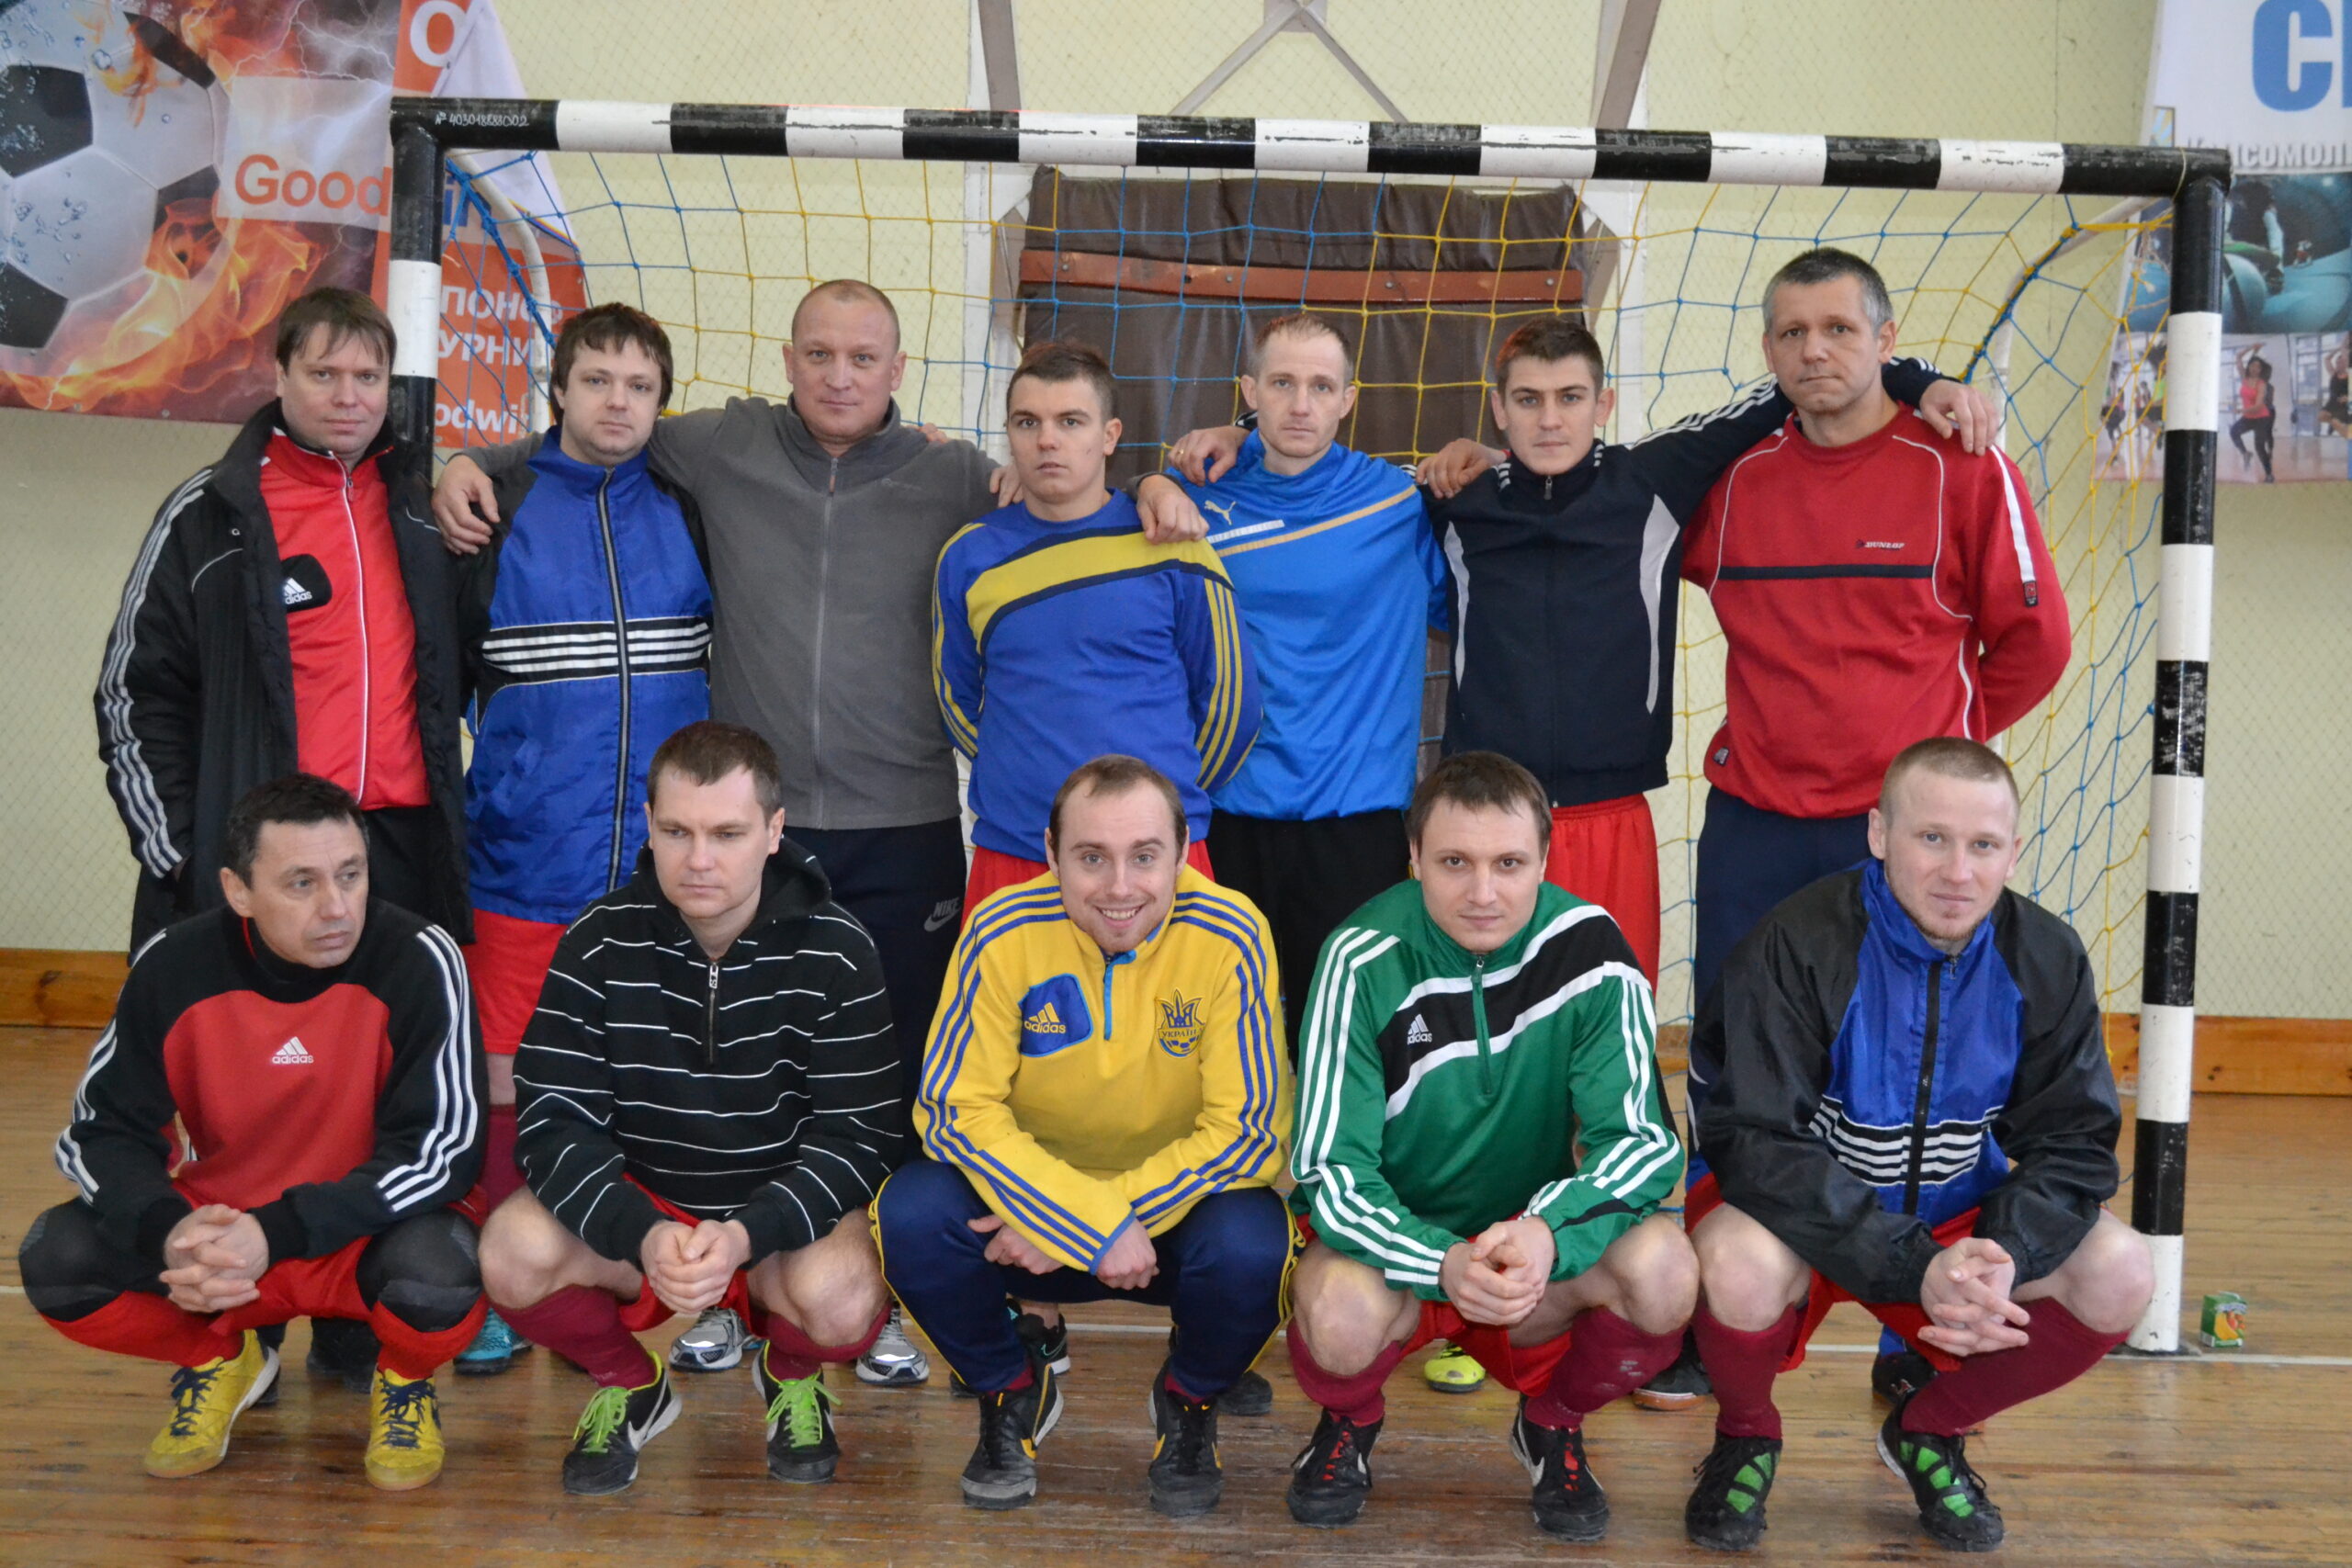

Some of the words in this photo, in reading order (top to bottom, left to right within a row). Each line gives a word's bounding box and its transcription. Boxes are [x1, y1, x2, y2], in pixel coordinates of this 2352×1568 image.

[1864, 541, 1905, 549] DUNLOP
[285, 591, 313, 604] didas
[933, 897, 961, 918] NIKE
[1024, 1021, 1067, 1034] adidas
[272, 1055, 313, 1064] adidas
